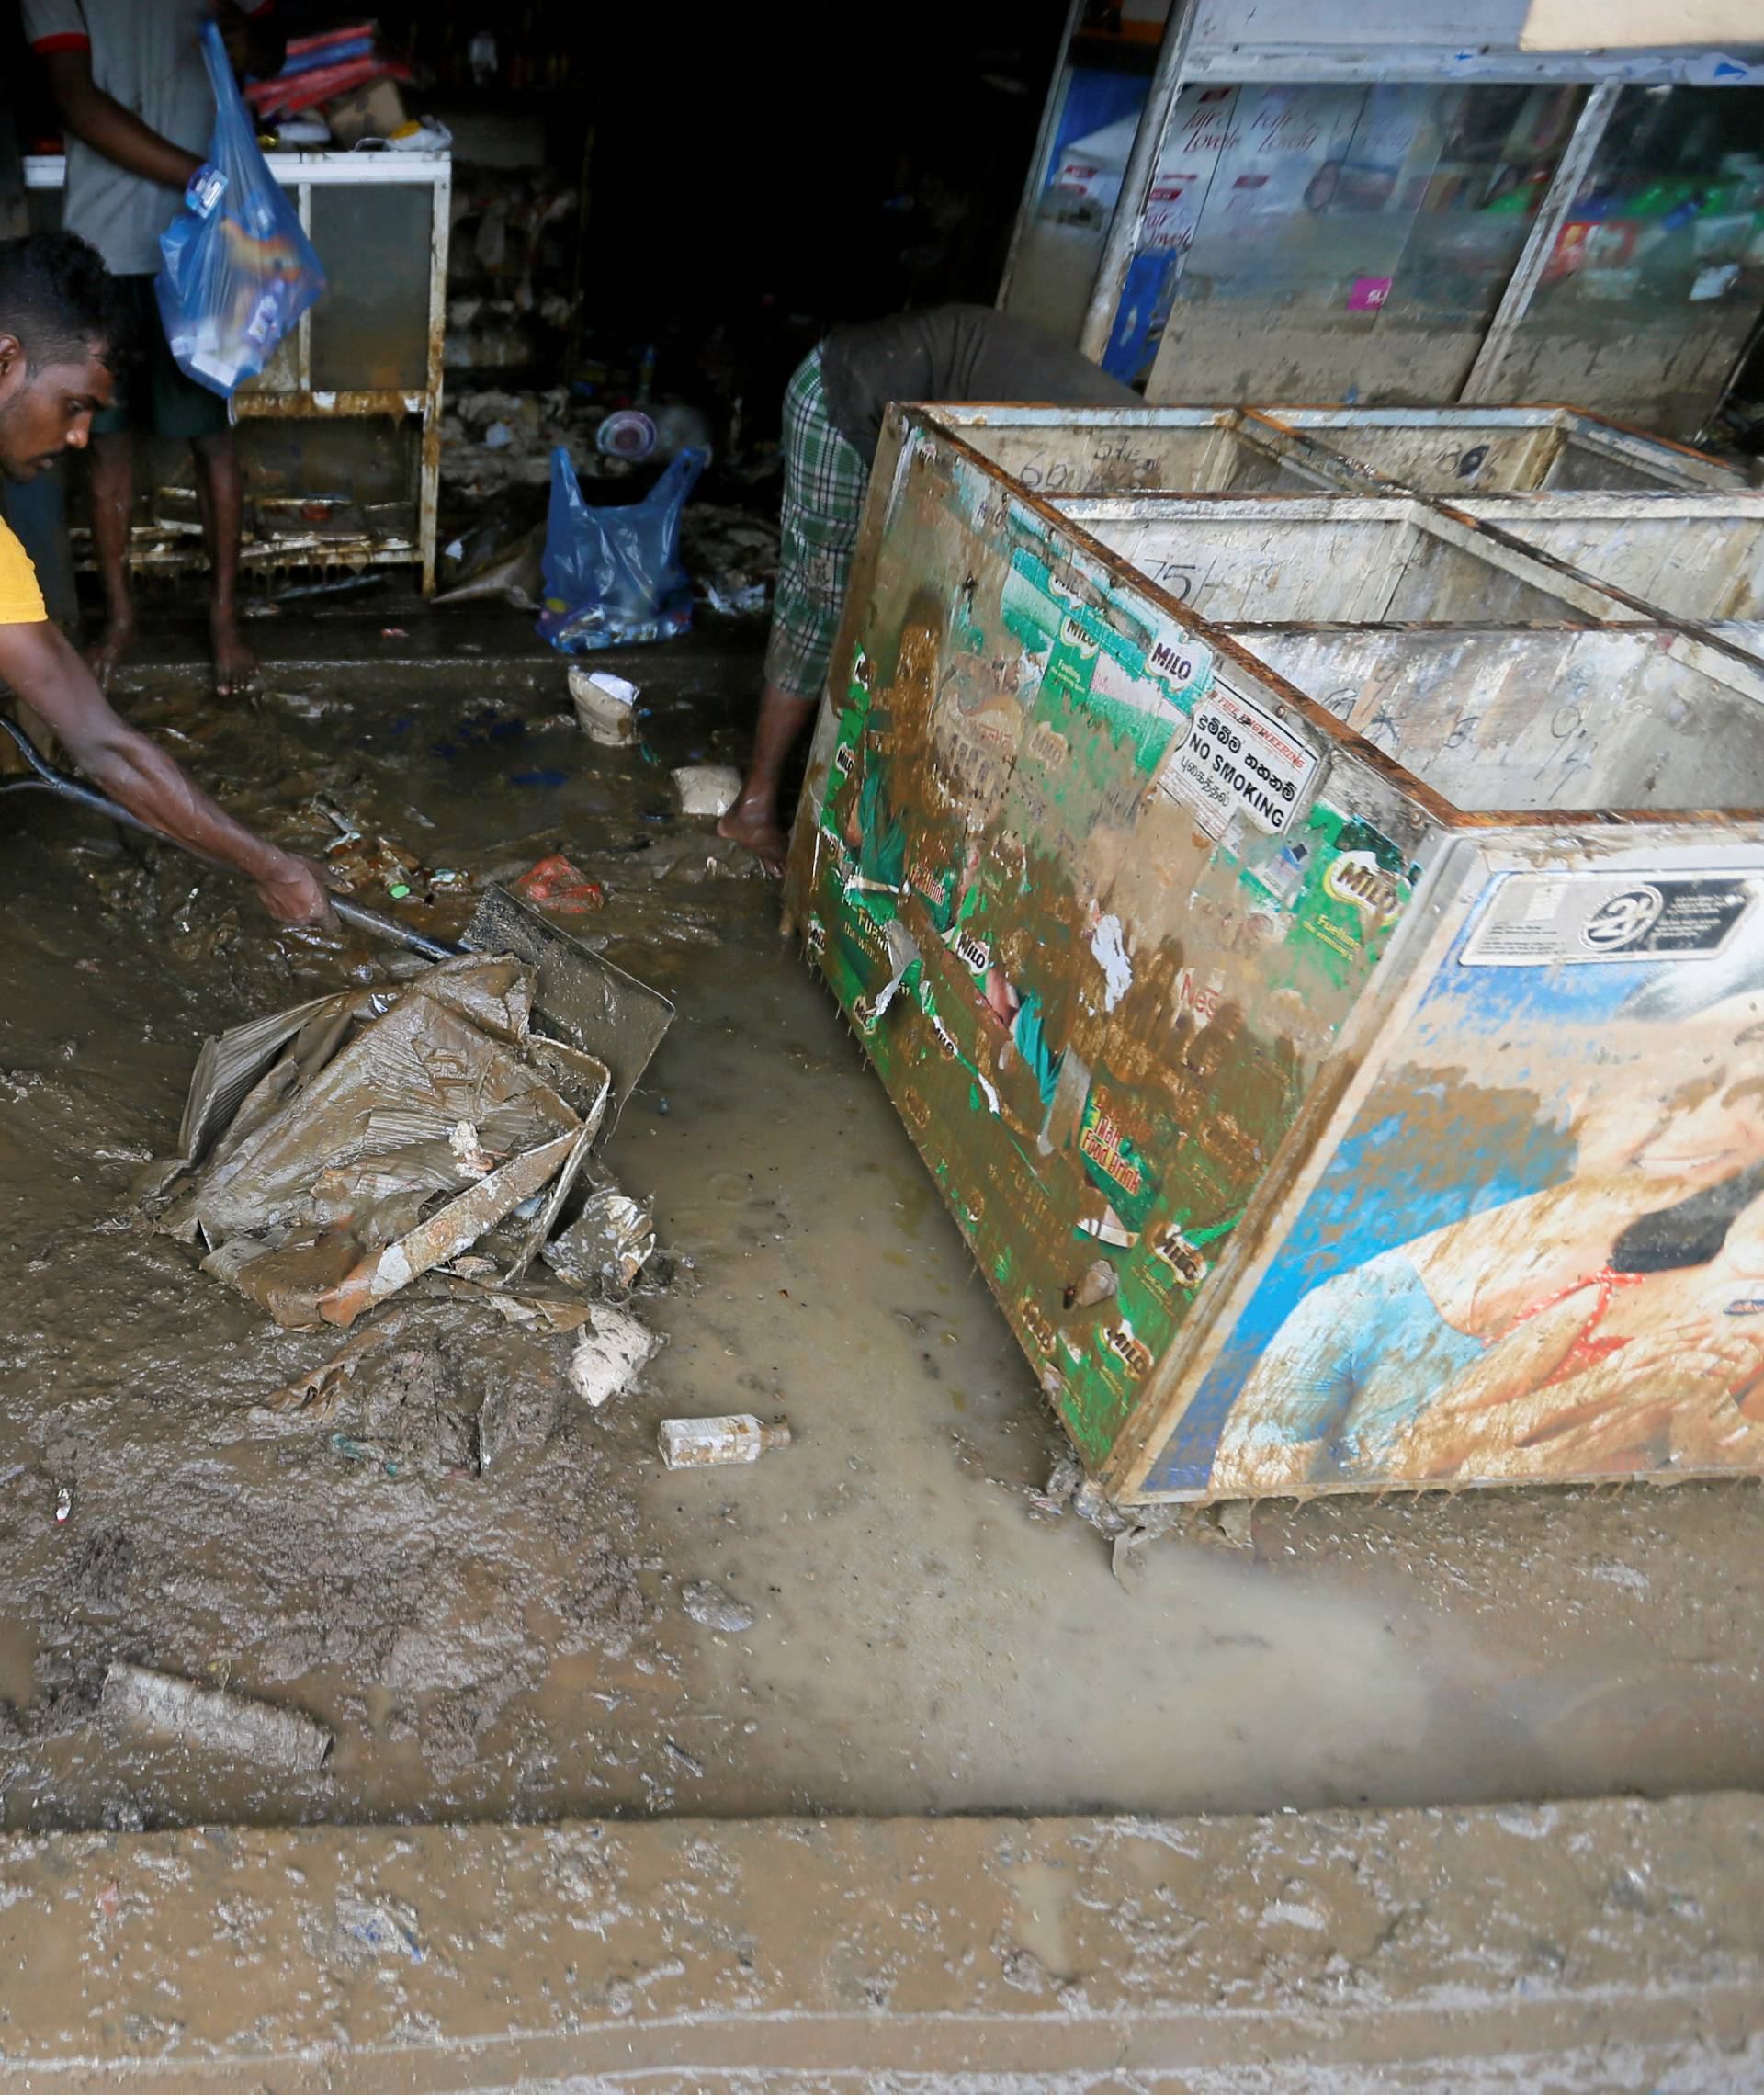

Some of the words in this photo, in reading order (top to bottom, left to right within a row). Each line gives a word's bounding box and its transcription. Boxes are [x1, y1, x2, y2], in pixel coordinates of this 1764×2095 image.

[1150, 642, 1192, 681] MILO
[1189, 733, 1211, 760] NO
[1212, 754, 1284, 828] SMOKING
[1337, 861, 1397, 915] MILO
[1080, 1128, 1111, 1168] Food
